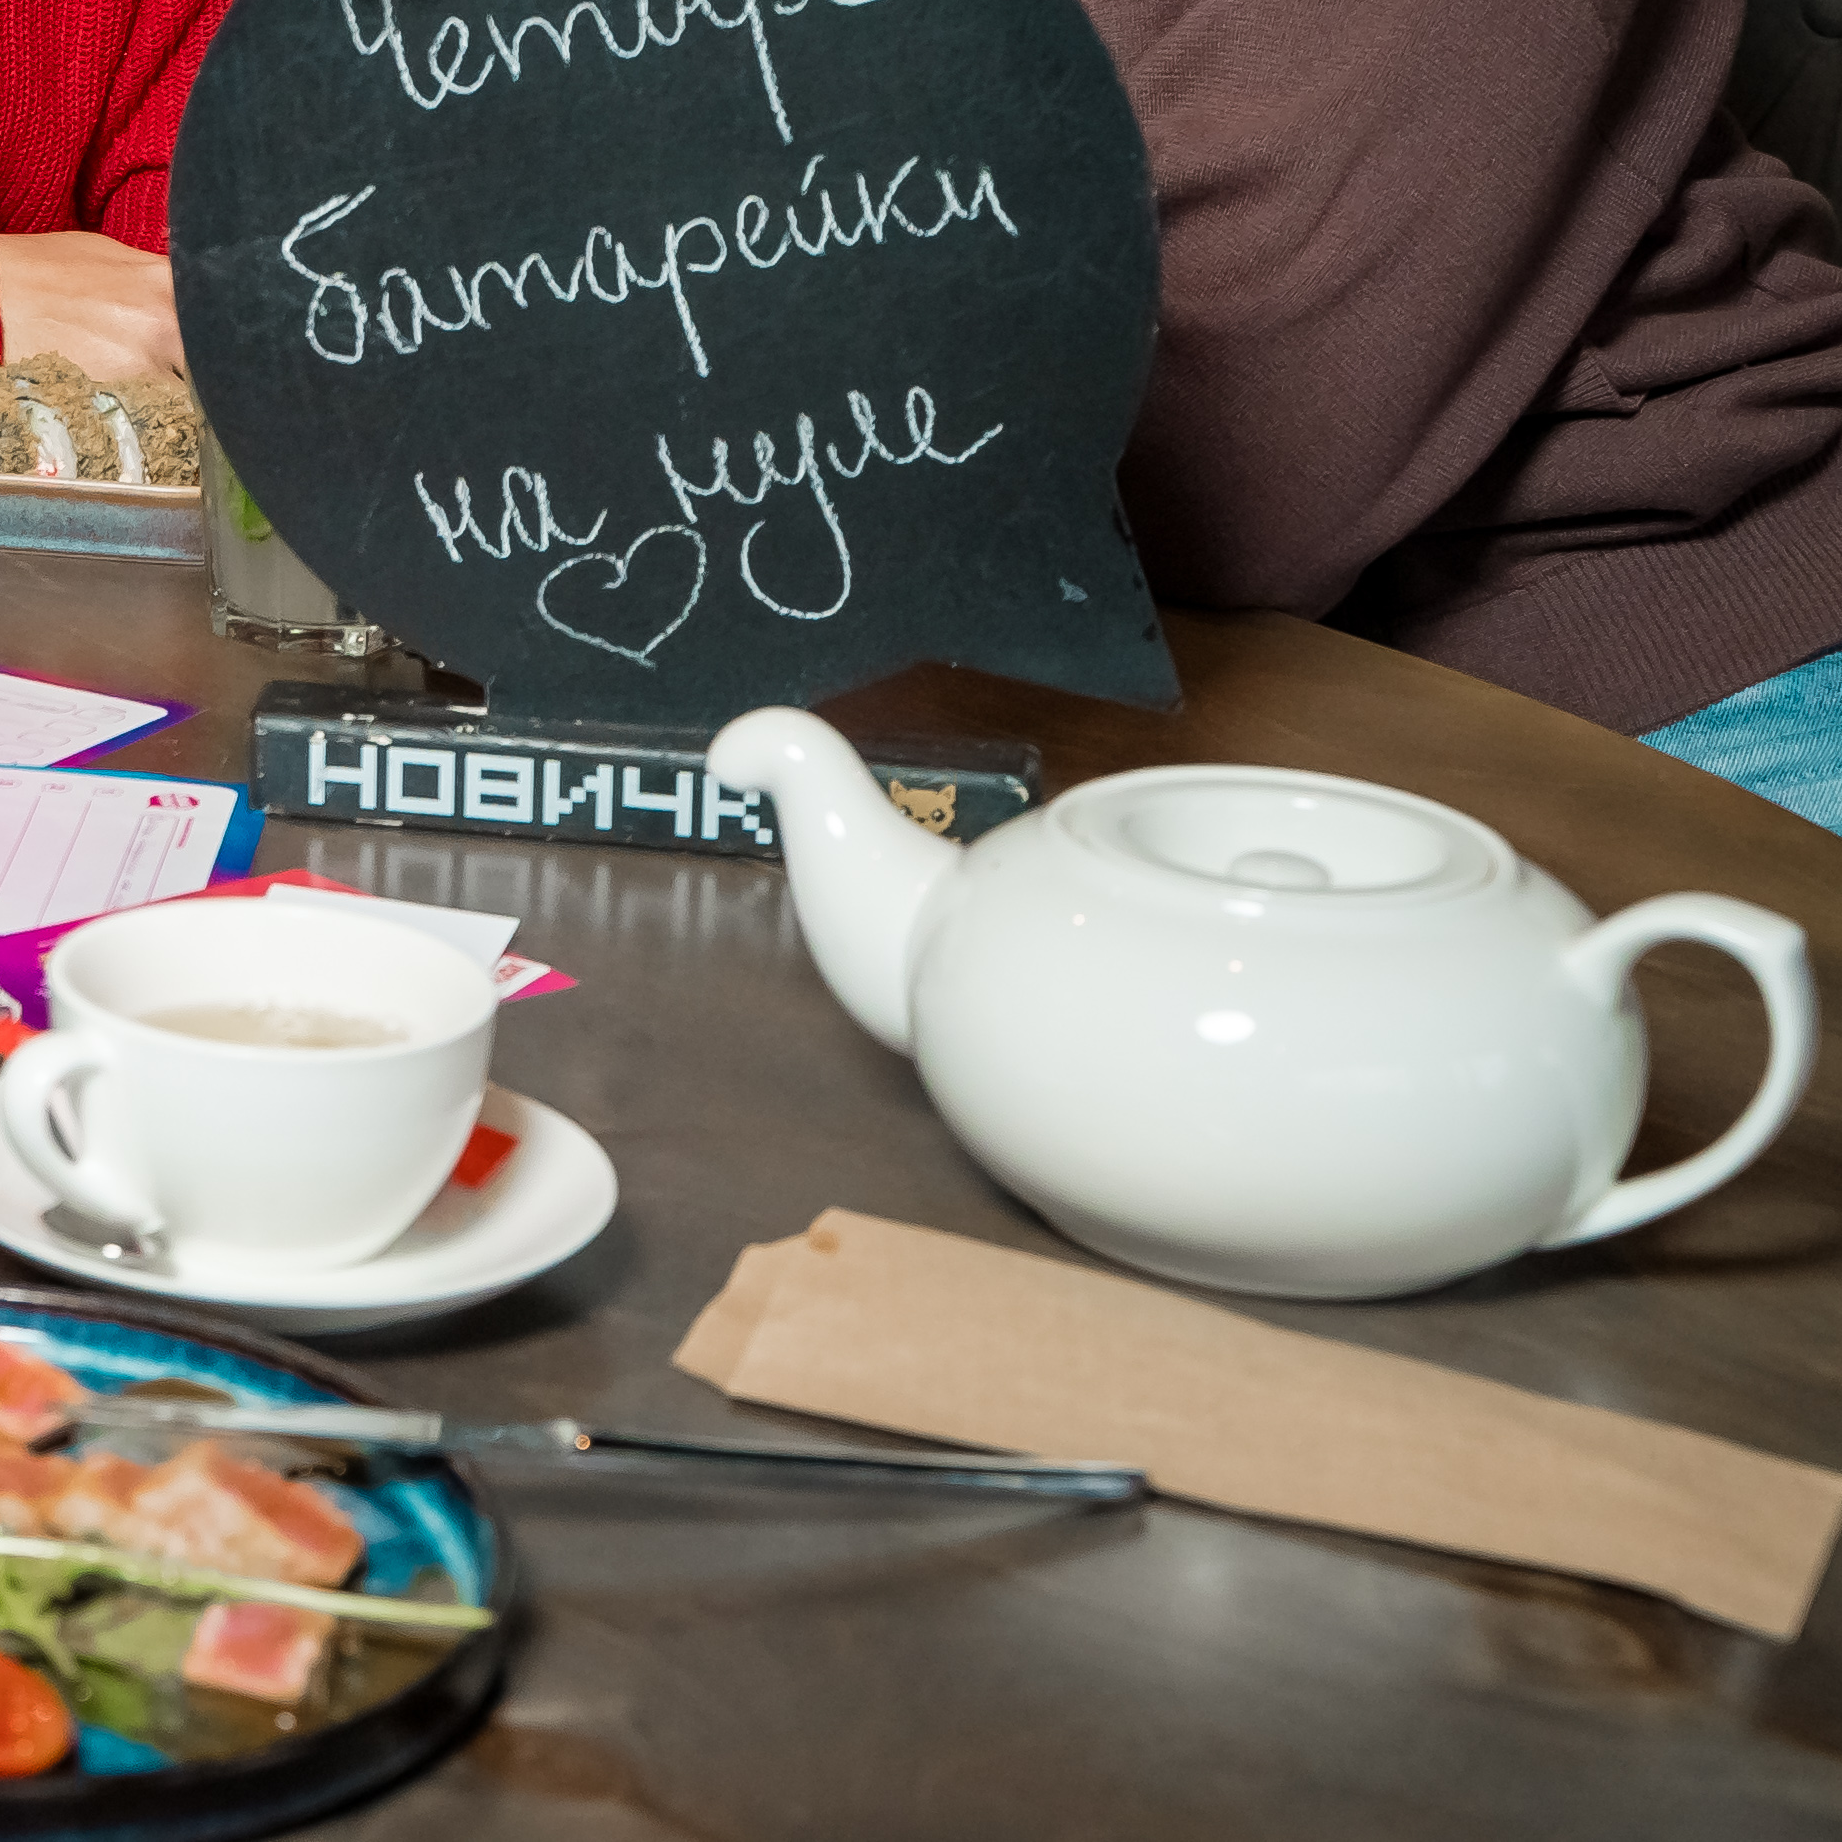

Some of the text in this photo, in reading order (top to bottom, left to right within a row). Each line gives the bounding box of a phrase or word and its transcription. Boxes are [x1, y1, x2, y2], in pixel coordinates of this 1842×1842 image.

[280, 155, 1019, 379] батарейки
[414, 385, 1003, 620] на нуле
[307, 736, 774, 846] НОВИЧК
